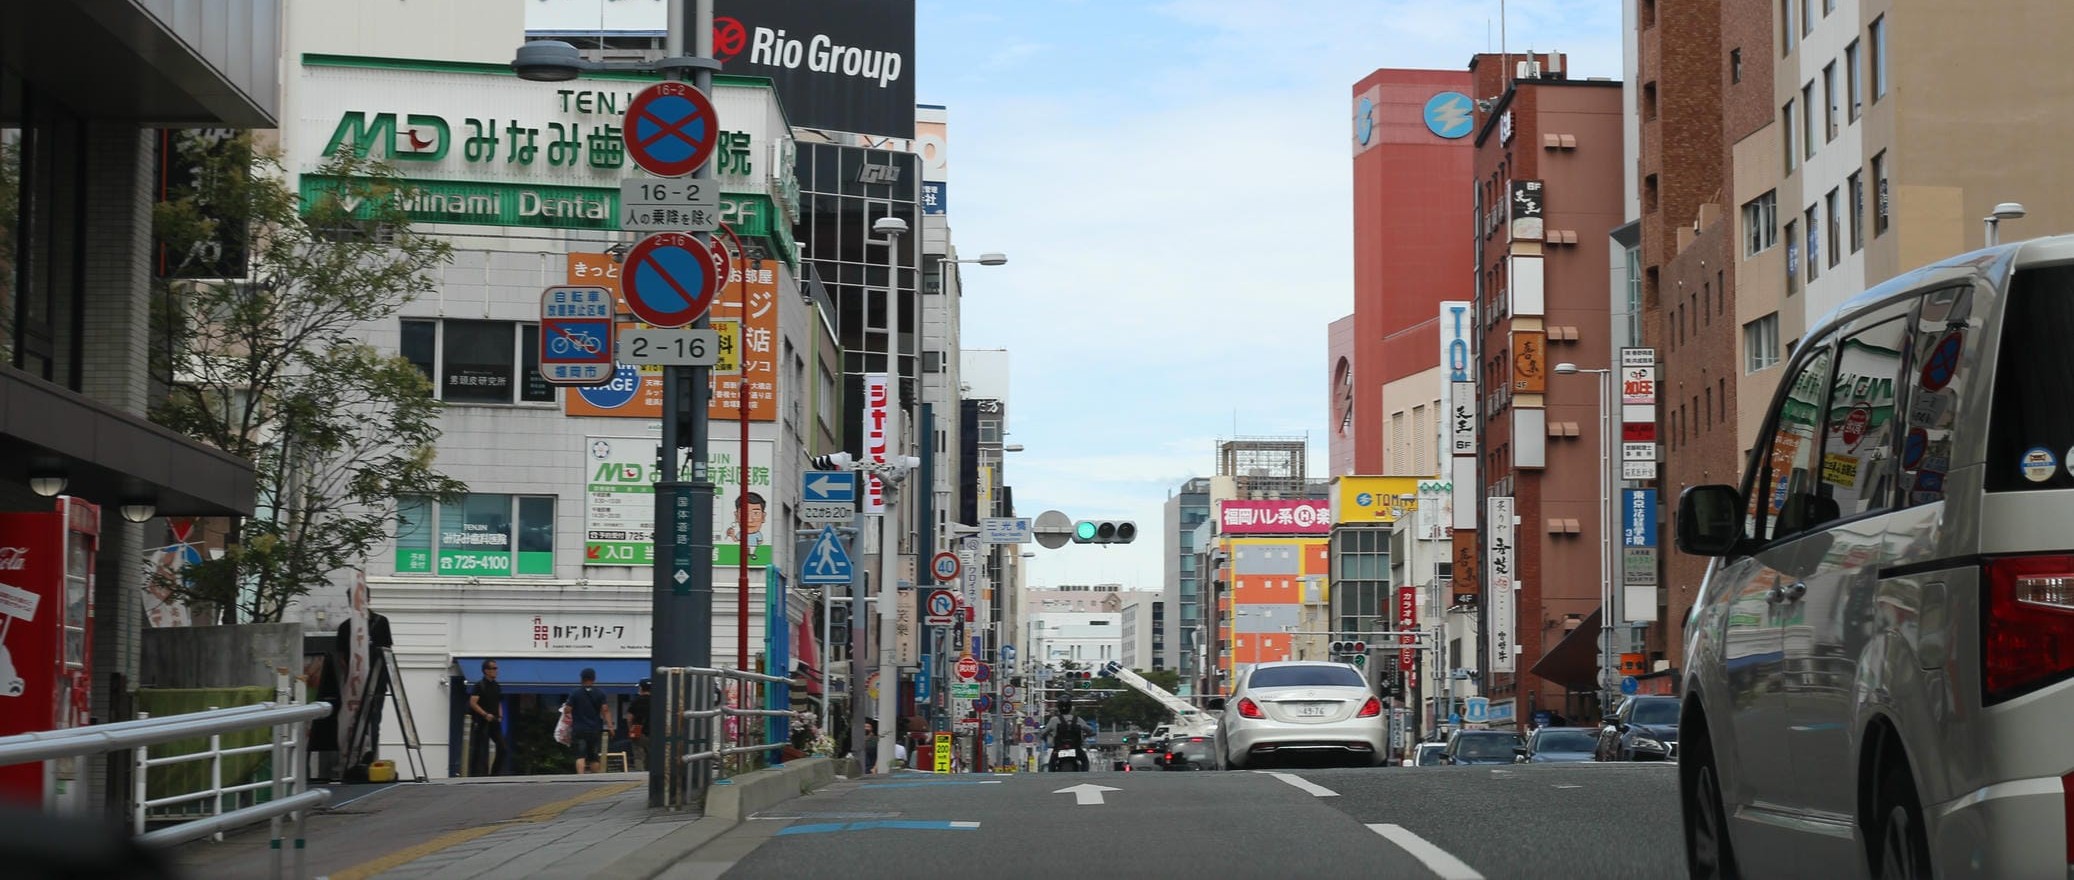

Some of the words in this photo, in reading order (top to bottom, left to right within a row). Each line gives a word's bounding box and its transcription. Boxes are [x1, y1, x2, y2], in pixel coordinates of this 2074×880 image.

[751, 27, 803, 69] Rio
[808, 34, 902, 88] Group
[656, 85, 686, 95] 16-2
[464, 118, 752, 174] みなみ歯院
[641, 184, 700, 201] 16-2
[394, 188, 500, 215] Minami
[518, 192, 610, 219] Dental
[626, 209, 713, 225] 人の乗降を除く
[654, 235, 686, 246] 2-16
[574, 261, 618, 278] きっと
[555, 291, 600, 303] 自転車
[548, 304, 606, 316] 放置禁止区域
[632, 337, 705, 358] 2-16
[555, 366, 598, 378] 福岡市
[1456, 440, 1472, 450] 6F
[1224, 508, 1293, 526] 福岡ハレ系
[464, 523, 488, 531] TENJIN
[987, 520, 1026, 531] 三光橋
[443, 533, 507, 545] みなみ歯科医院
[606, 546, 634, 560] 入口
[454, 555, 509, 569] 725-4100
[938, 560, 954, 572] 40
